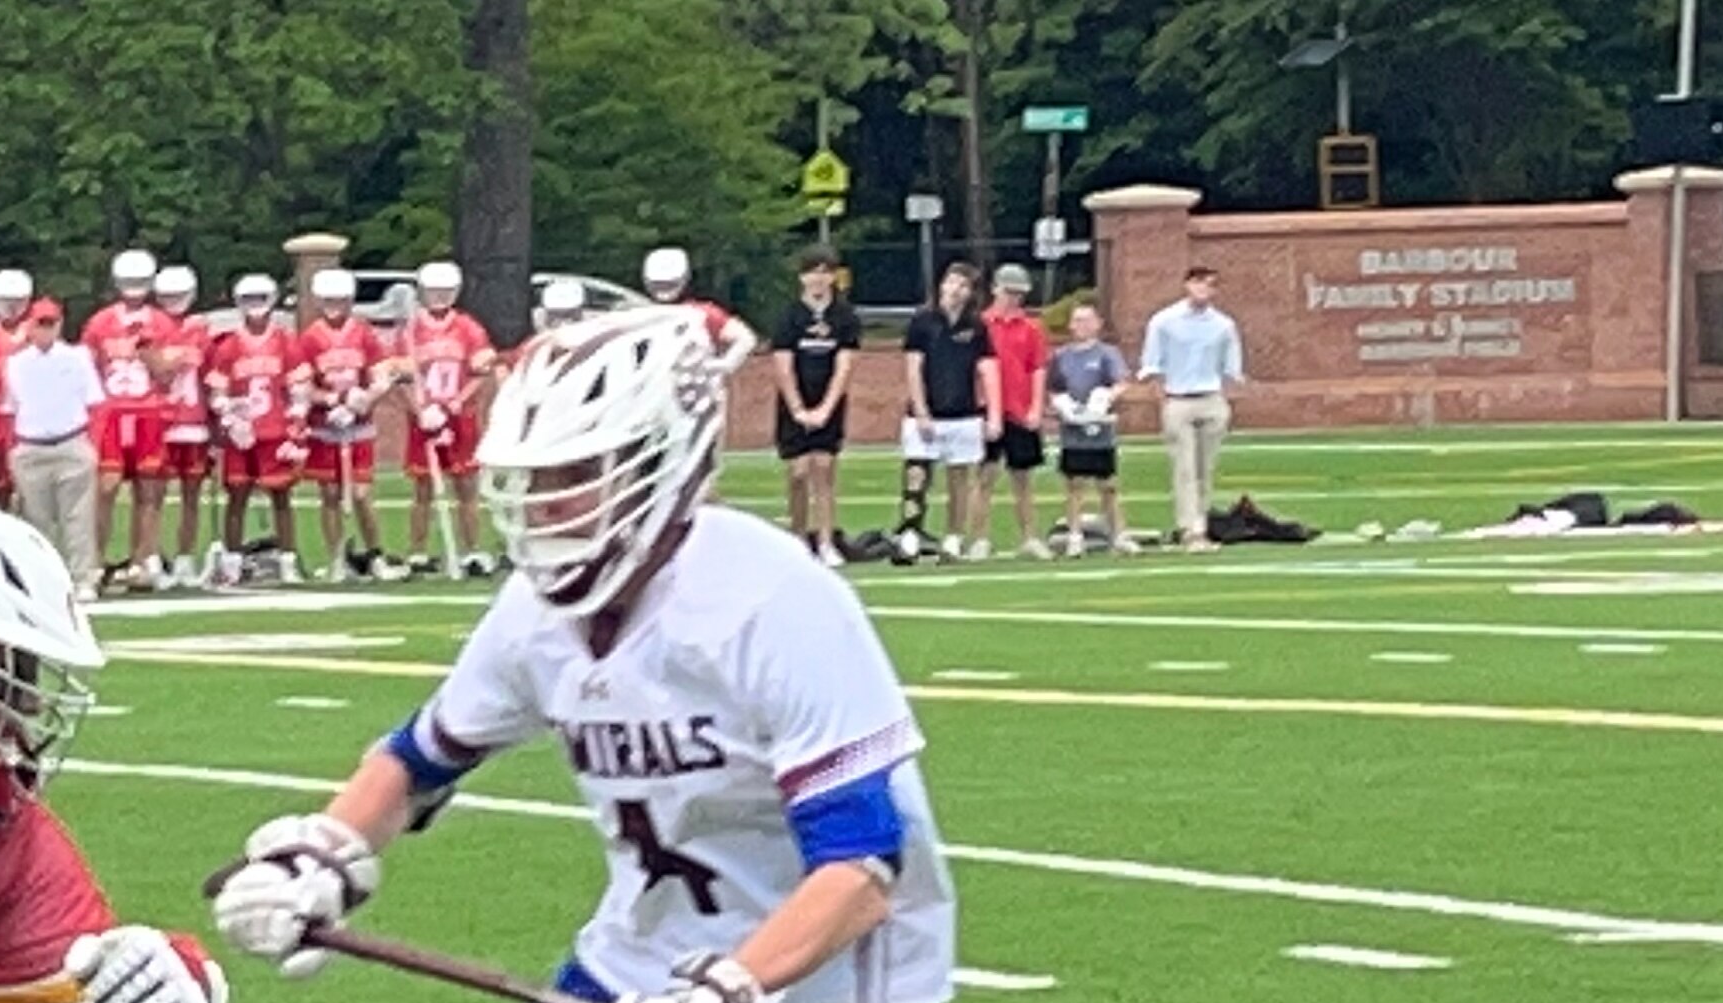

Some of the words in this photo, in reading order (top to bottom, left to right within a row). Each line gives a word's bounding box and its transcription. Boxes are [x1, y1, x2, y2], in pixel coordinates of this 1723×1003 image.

[1360, 248, 1517, 275] BARBOUR
[1307, 283, 1422, 309] FAMILY
[1430, 279, 1575, 306] STADIUM
